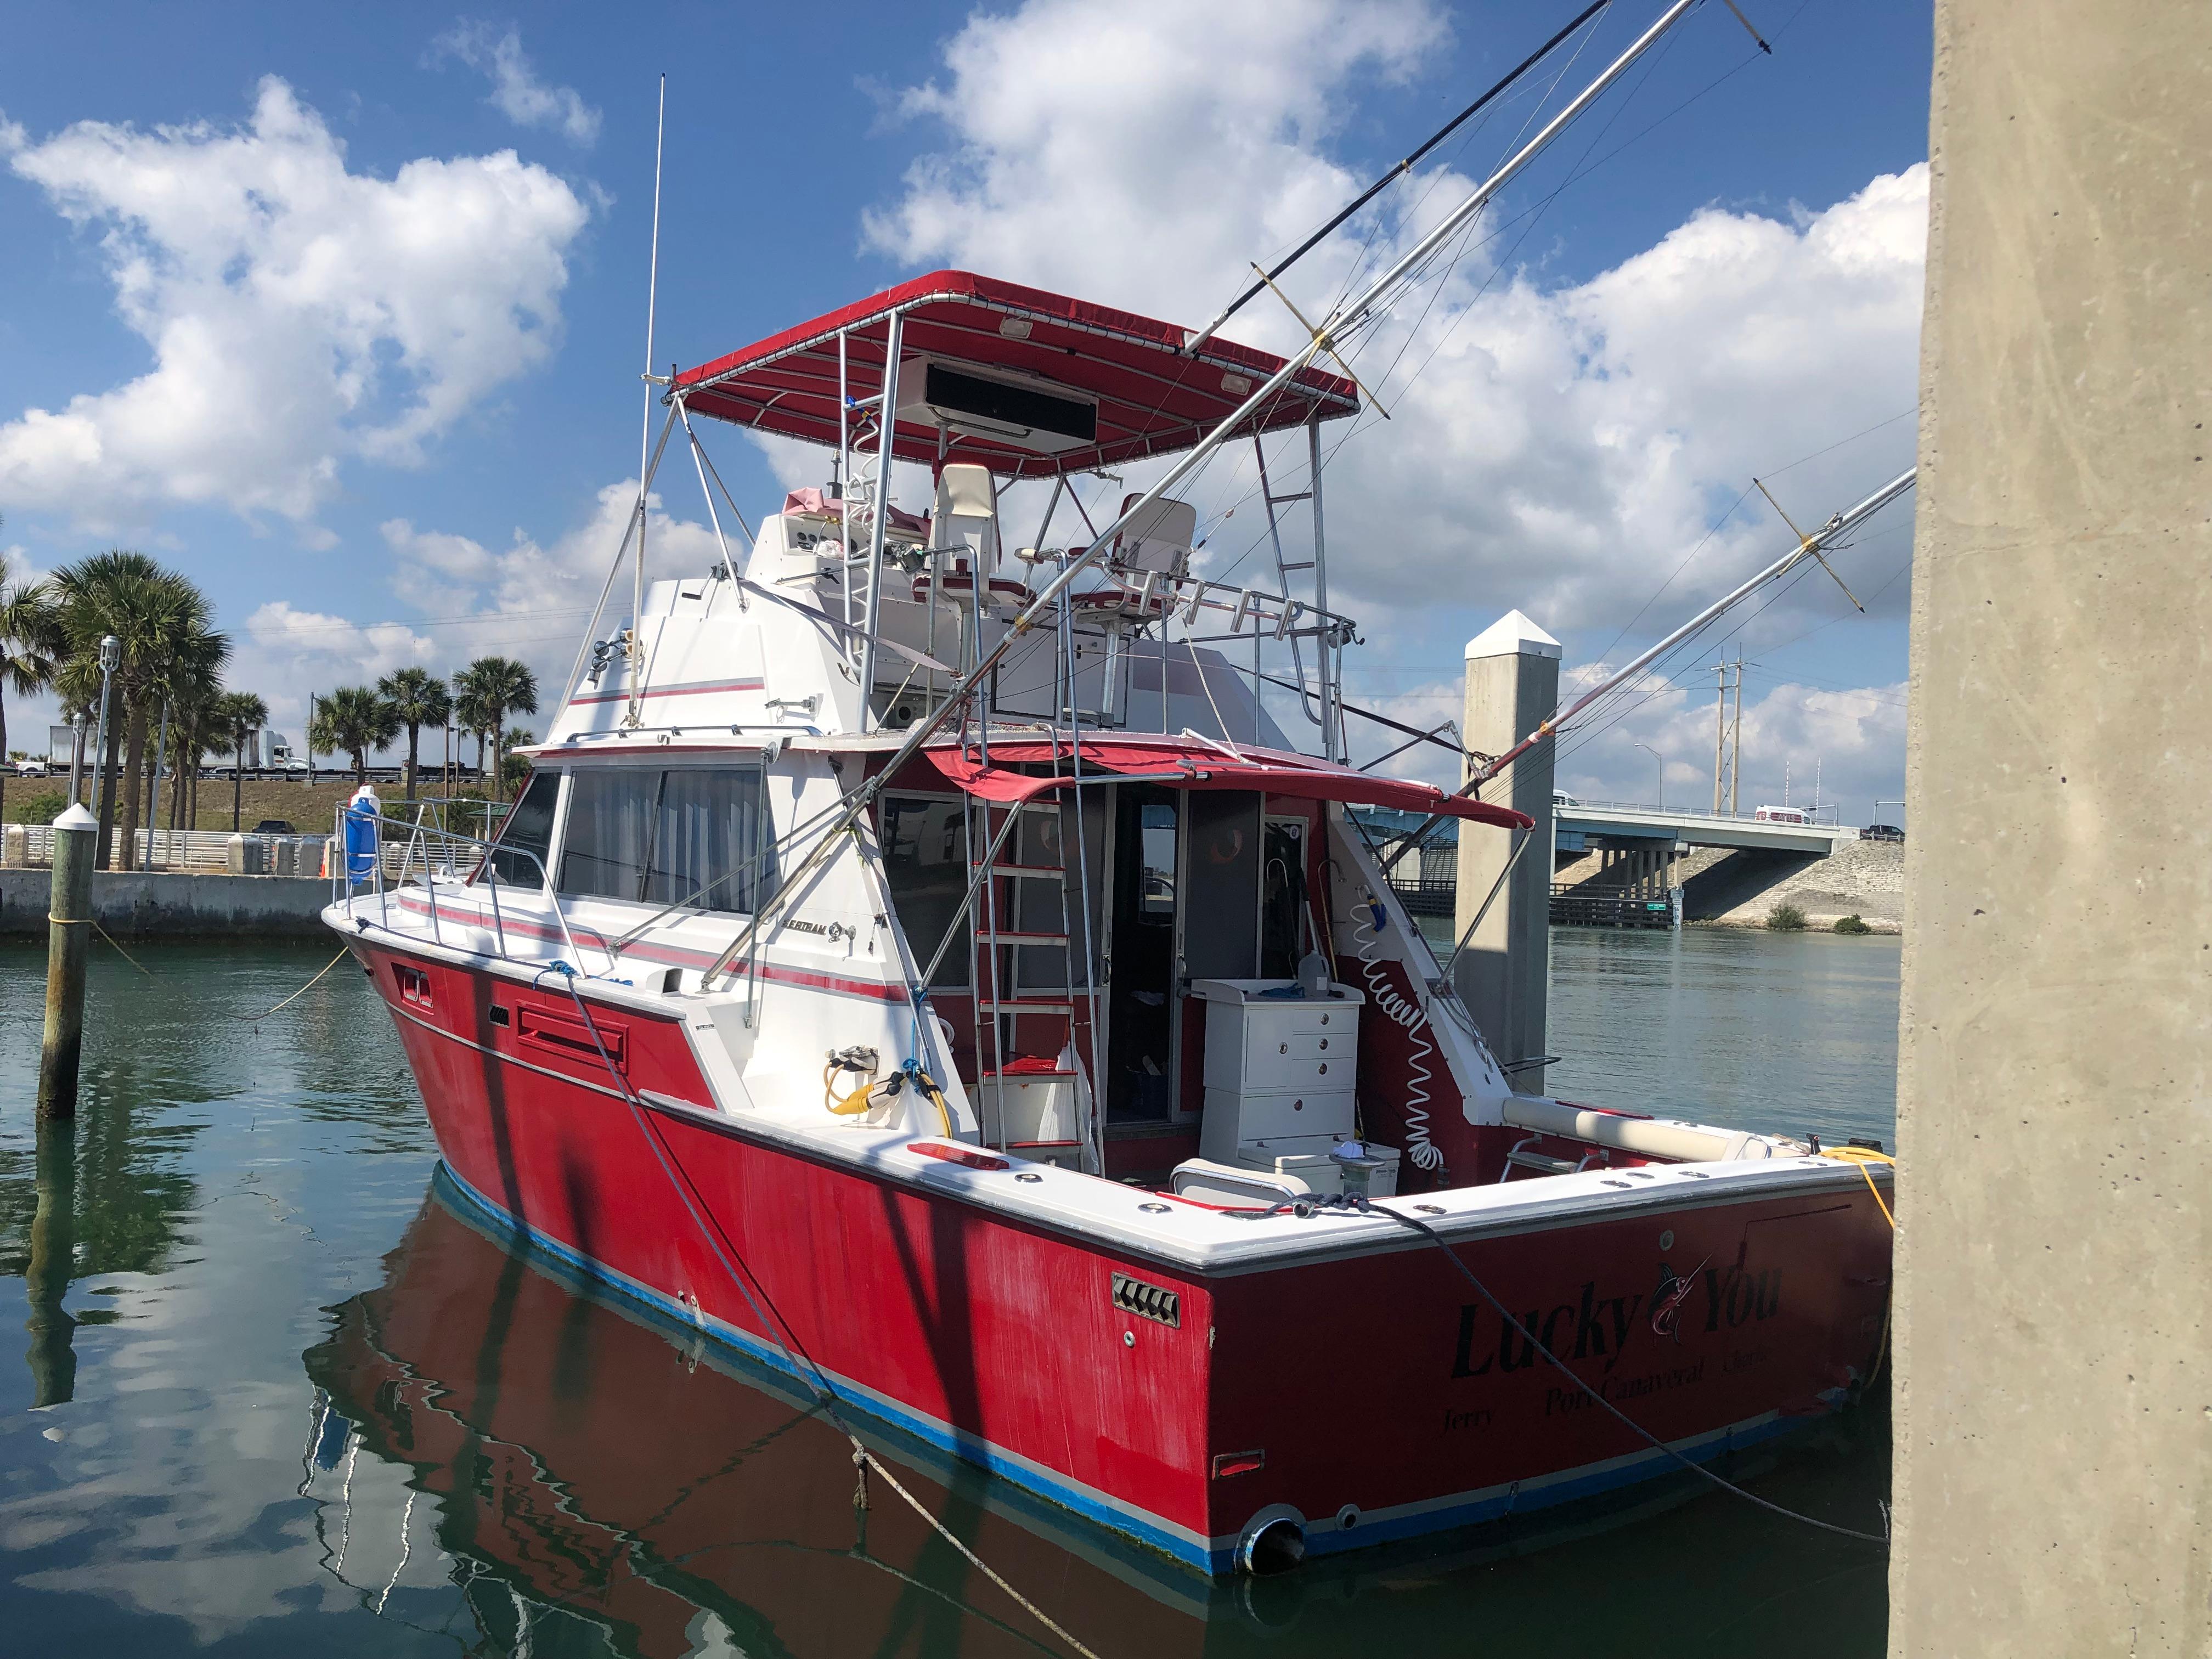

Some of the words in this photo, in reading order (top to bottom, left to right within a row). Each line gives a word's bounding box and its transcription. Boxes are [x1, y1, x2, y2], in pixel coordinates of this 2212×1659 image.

[781, 918, 827, 935] BERTRAM
[1451, 1281, 1644, 1378] Lucky
[1703, 1265, 1782, 1333] You
[1440, 1409, 1496, 1438] Jerry
